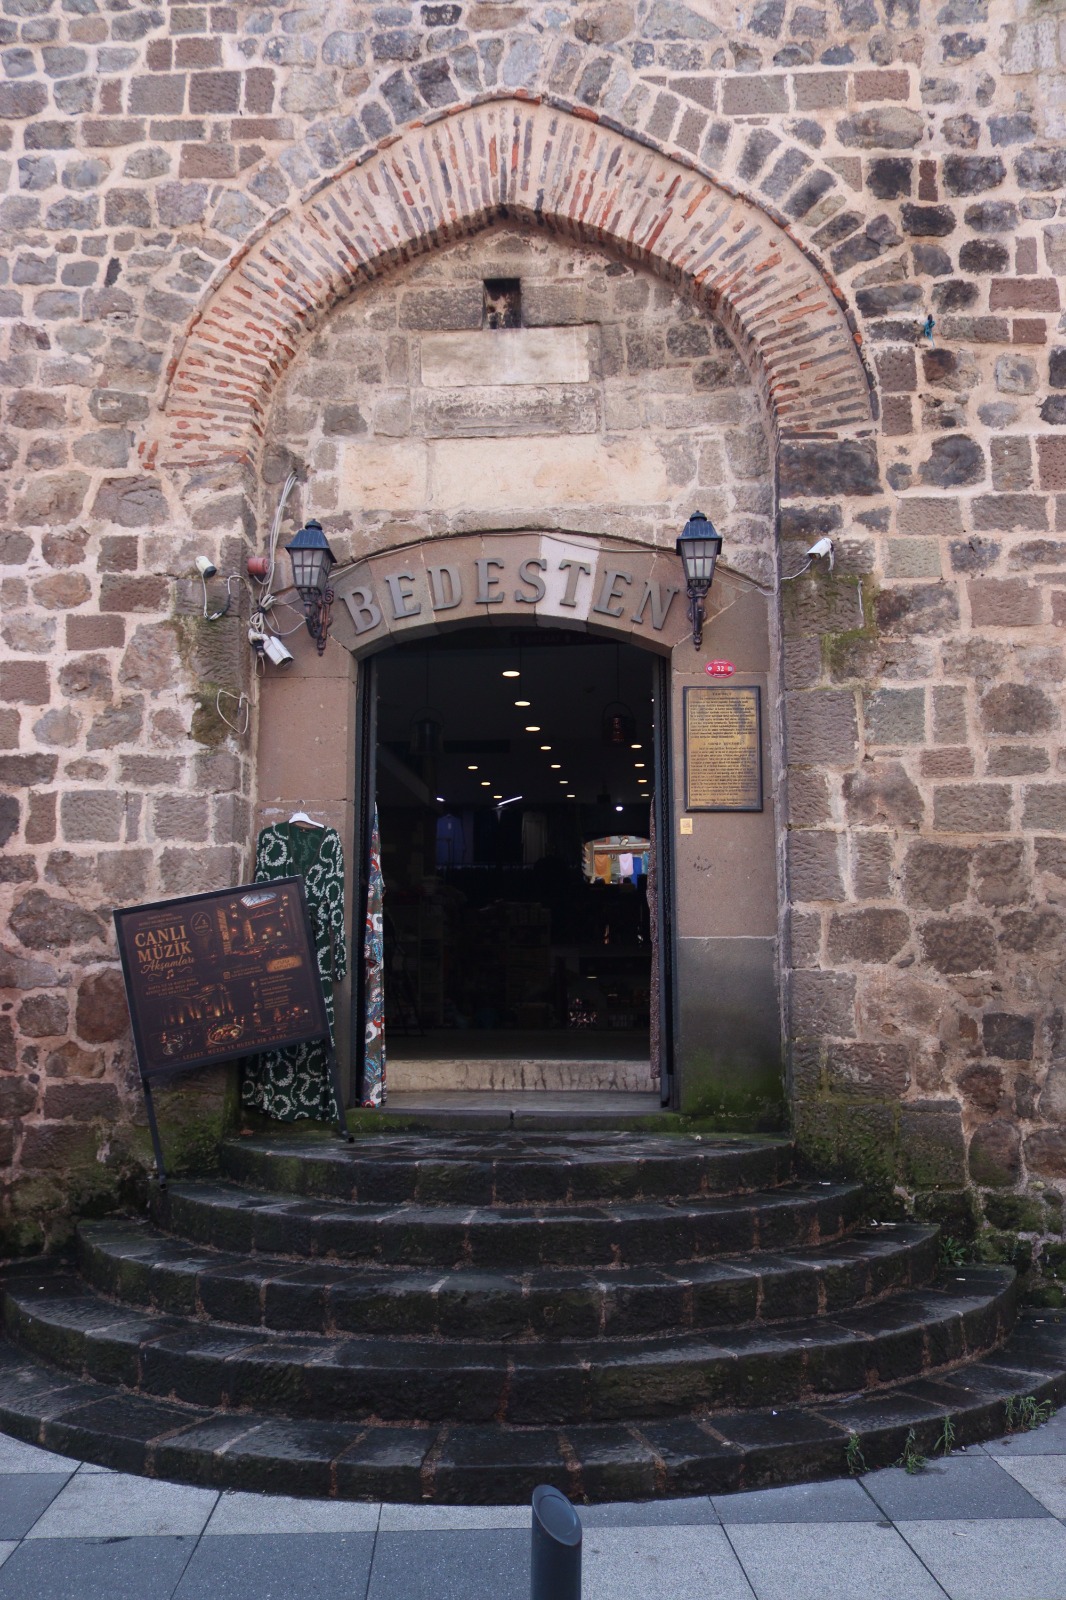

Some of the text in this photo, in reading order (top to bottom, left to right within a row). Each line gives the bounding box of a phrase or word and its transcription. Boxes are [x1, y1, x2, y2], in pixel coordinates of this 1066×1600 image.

[339, 558, 680, 636] BEDESTEN
[135, 925, 187, 947] CANLI
[137, 940, 192, 963] MÜZİK
[140, 955, 195, 974] Akşamları
